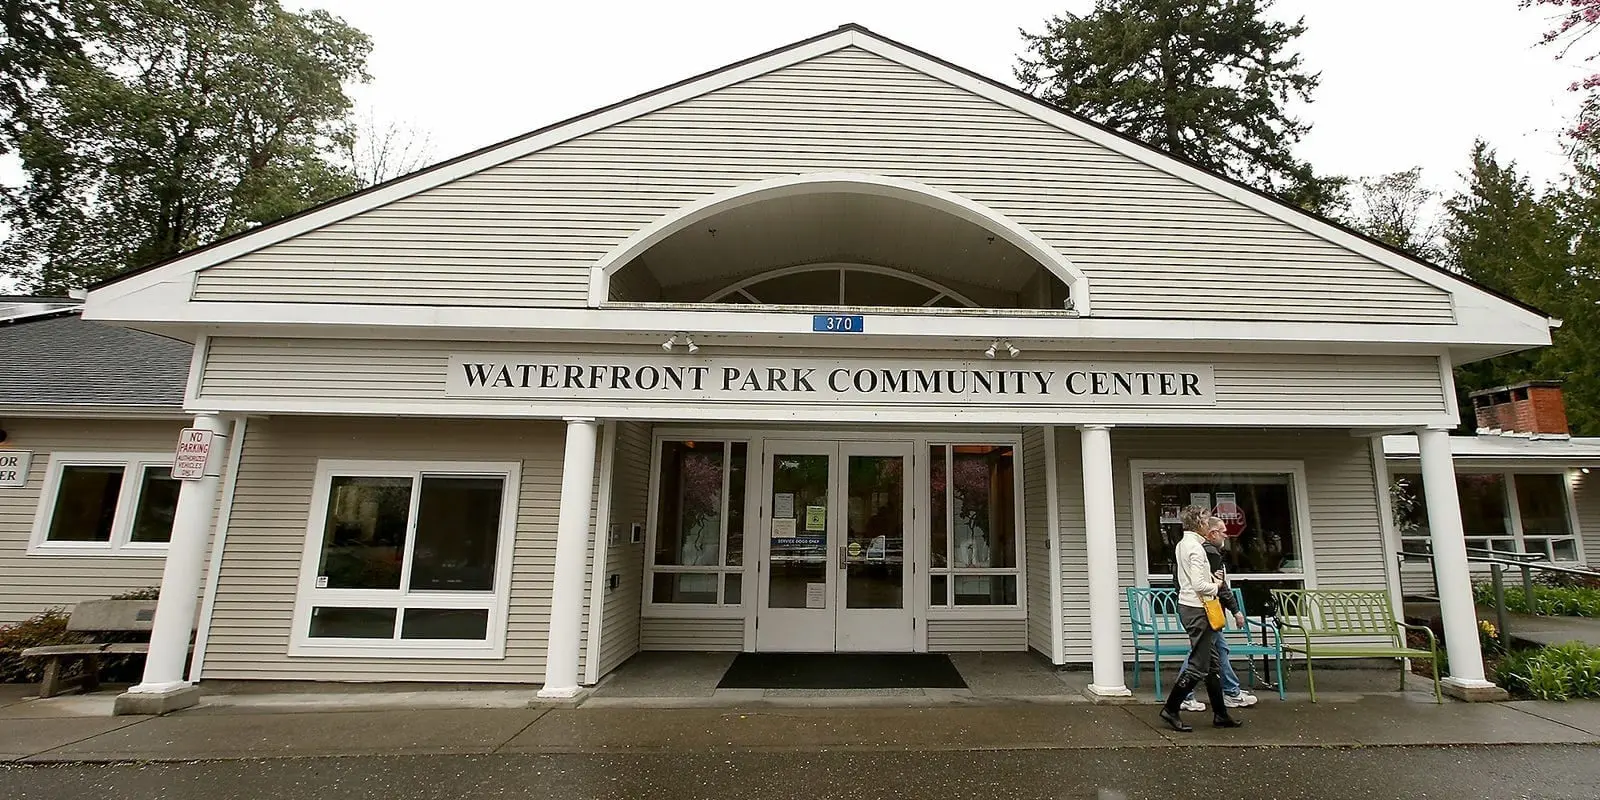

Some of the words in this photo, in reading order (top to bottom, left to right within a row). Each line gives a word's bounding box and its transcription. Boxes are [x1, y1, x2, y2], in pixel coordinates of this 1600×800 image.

[827, 317, 852, 330] 370
[463, 363, 709, 391] WATERFRONT
[721, 367, 816, 392] PARK
[827, 369, 1054, 395] COMMUNITY
[1065, 371, 1202, 396] CENTER
[190, 432, 203, 442] NO
[180, 443, 208, 453] PARKING
[0, 456, 18, 466] OR
[0, 470, 16, 481] ER
